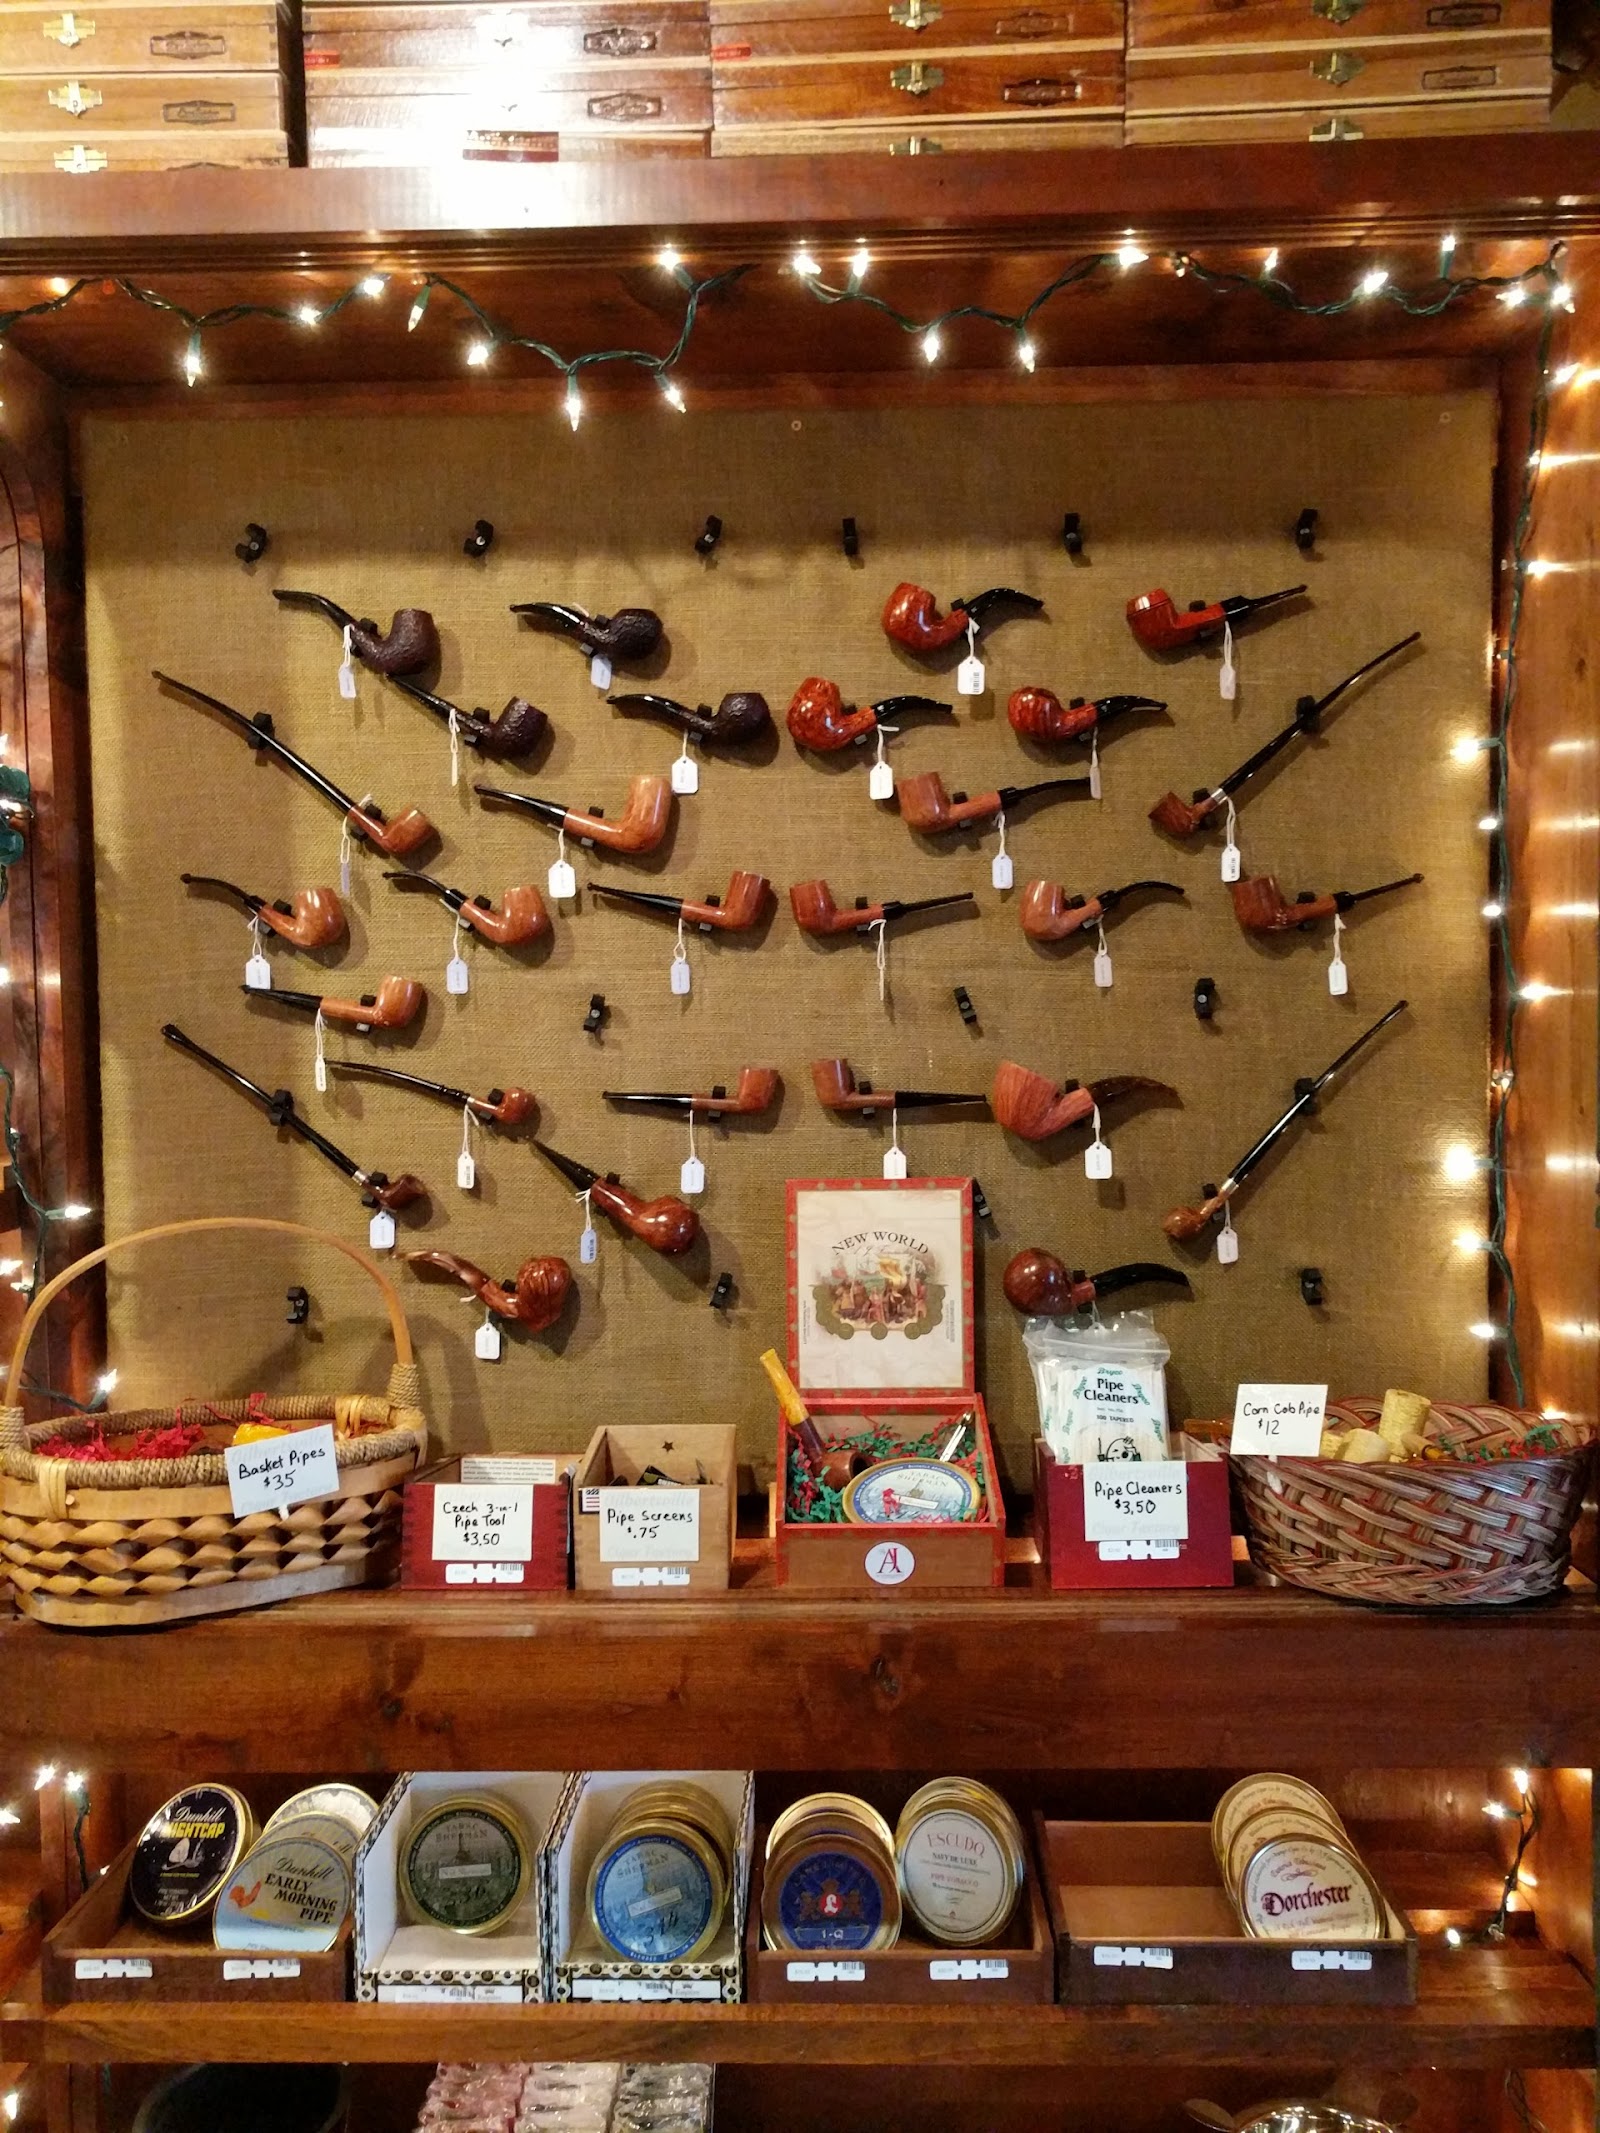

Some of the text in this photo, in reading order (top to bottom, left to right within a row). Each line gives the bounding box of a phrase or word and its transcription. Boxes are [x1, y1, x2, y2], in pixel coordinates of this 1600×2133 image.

[832, 1233, 869, 1255] NEW
[873, 1231, 929, 1255] WORLD
[1097, 1378, 1124, 1392] Pipe
[1084, 1389, 1139, 1404] Cleaners
[1243, 1401, 1320, 1418] Corn Cob Pipe
[1258, 1418, 1280, 1436] $12
[239, 1447, 326, 1480] Basket Pipes
[263, 1469, 297, 1491] $35
[1094, 1481, 1182, 1500] Pipe Cleaners
[443, 1501, 518, 1514] Czech 3-in-1
[455, 1513, 505, 1530] Pipe Tool
[607, 1508, 693, 1526] Pipe Screens
[463, 1532, 500, 1547] $3.50
[627, 1525, 660, 1538] $.75
[174, 1805, 227, 1822] Dunhill
[927, 1832, 985, 1859] ESCUDO
[275, 1857, 335, 1880] Dunhill
[264, 1872, 313, 1892] EARLY
[273, 1889, 338, 1912] MORNING
[1260, 1881, 1353, 1917] Dorchester
[300, 1906, 335, 1925] PIPE
[821, 1928, 844, 1940] 1-Q
